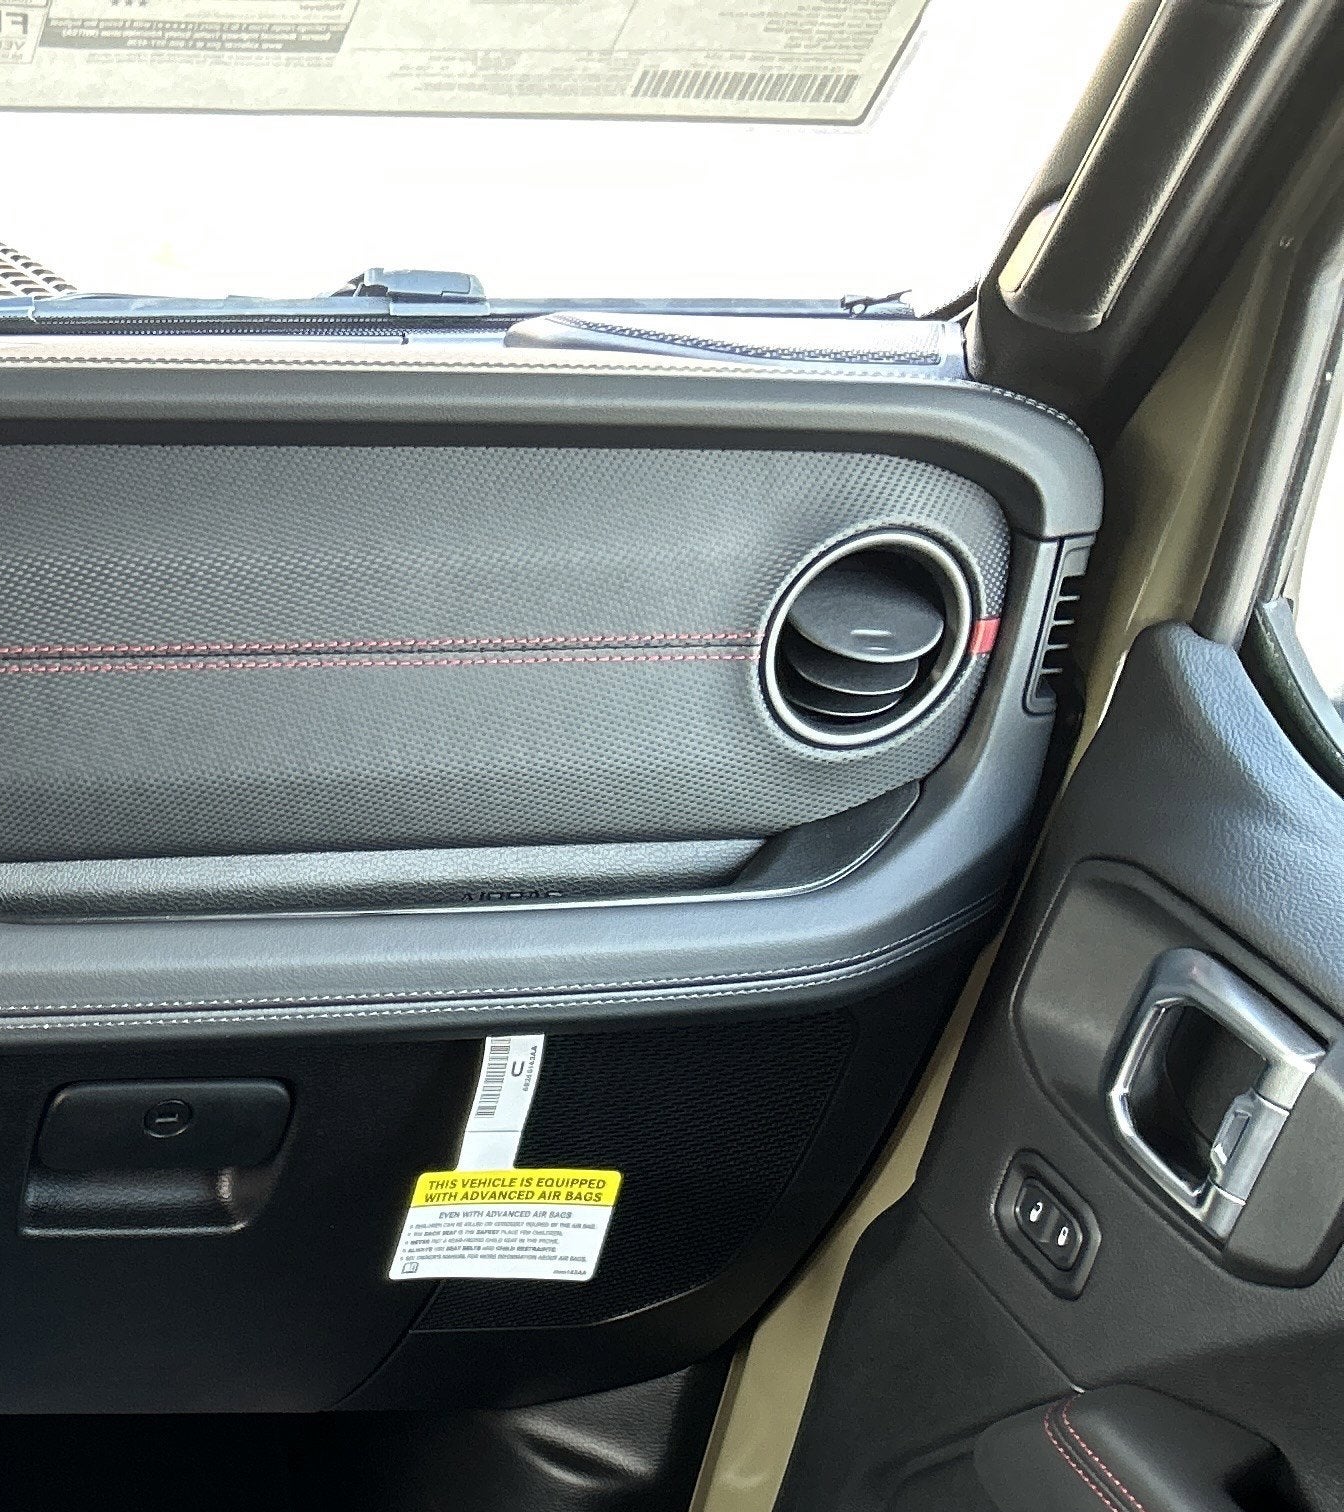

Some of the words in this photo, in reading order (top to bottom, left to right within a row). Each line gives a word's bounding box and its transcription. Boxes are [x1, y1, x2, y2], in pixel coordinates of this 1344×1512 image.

[511, 1060, 525, 1078] U
[428, 1178, 458, 1191] THIS
[461, 1177, 518, 1190] VEHICLE
[519, 1176, 534, 1189] IS
[535, 1177, 607, 1190] EQUIPPED
[424, 1191, 458, 1203] WITH
[459, 1190, 536, 1202] ADVANCED
[537, 1190, 562, 1202] AIR
[564, 1191, 604, 1203] BAGS
[438, 1211, 461, 1219] EVEN
[462, 1210, 485, 1218] WITH
[485, 1210, 532, 1218] ADVANCED
[532, 1210, 547, 1219] AIR
[548, 1211, 573, 1219] BAGS
